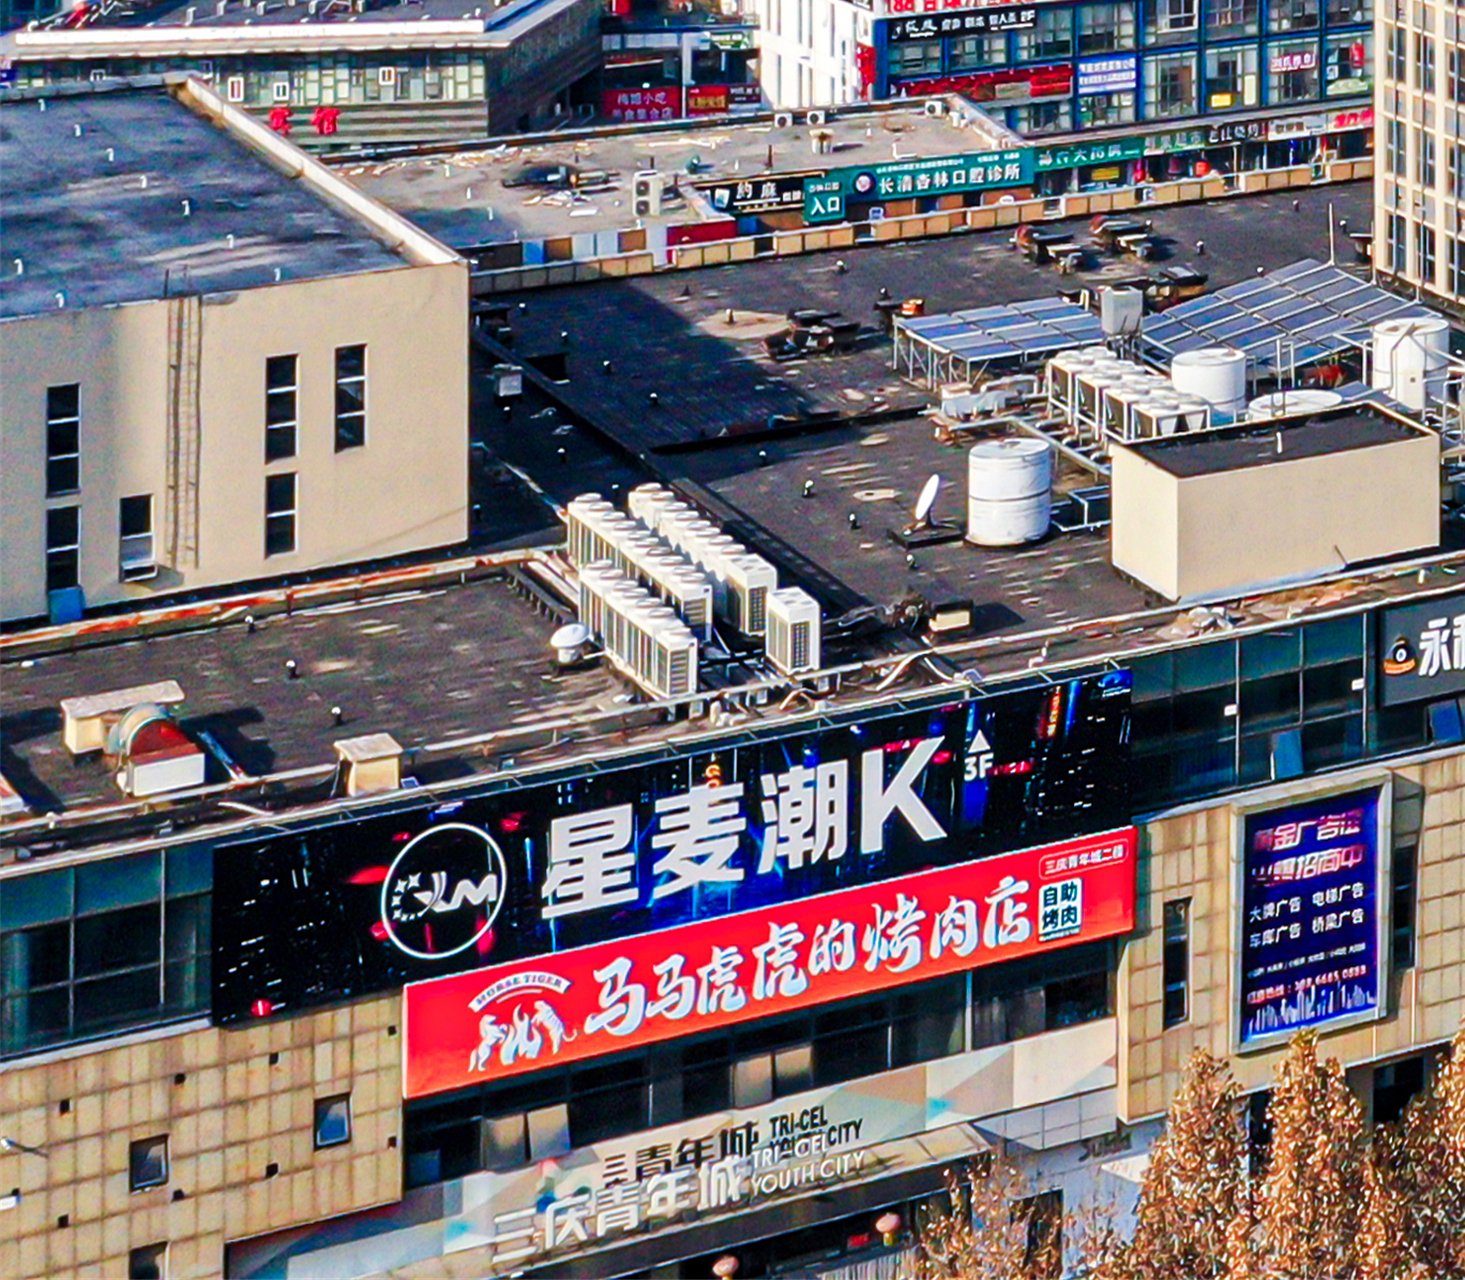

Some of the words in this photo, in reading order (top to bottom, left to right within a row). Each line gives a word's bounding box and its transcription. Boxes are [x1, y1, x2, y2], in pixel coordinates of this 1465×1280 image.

[811, 196, 840, 216] 入口
[964, 751, 993, 782] 3F
[541, 735, 947, 920] 星麦潮K
[1043, 880, 1078, 907] 自助
[1043, 904, 1078, 930] 烤肉
[585, 875, 1031, 1038] 马马虎虎的烤肉店
[525, 974, 563, 987] TIGER
[752, 1134, 829, 1169] TRI-CEL
[751, 1162, 815, 1197] YOUTH
[819, 1150, 865, 1183] CITY
[492, 1155, 744, 1265] 三庆青年城
